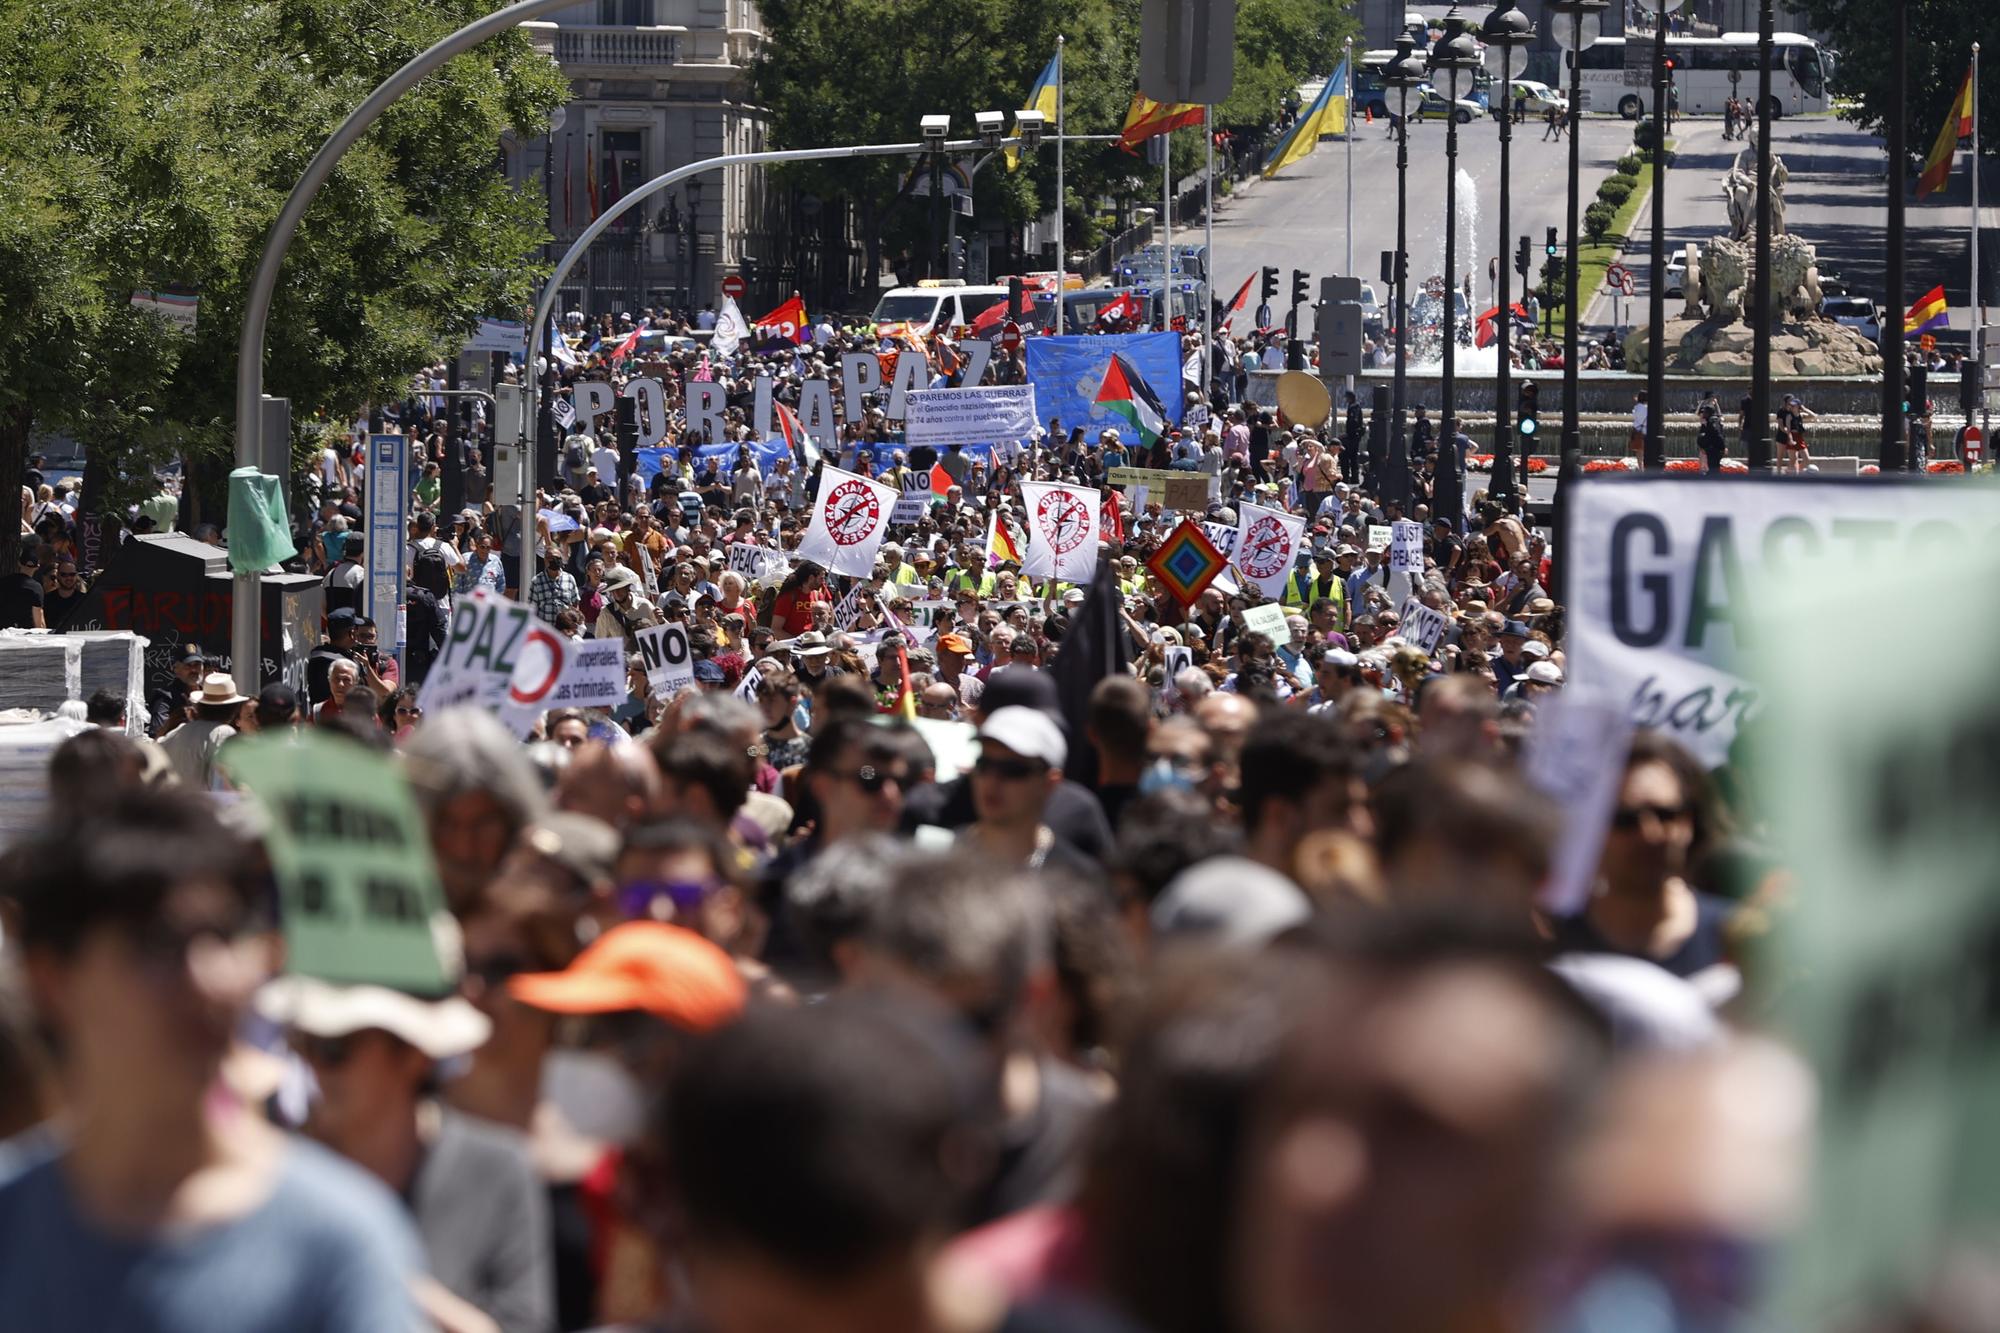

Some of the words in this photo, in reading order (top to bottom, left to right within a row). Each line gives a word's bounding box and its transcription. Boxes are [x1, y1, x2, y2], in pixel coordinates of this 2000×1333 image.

[573, 378, 726, 446] POR
[842, 340, 992, 422] PAZ
[920, 392, 962, 401] PAREMOS
[964, 390, 981, 399] LAS
[985, 389, 1028, 398] GUERRAS
[915, 416, 924, 424] 74
[926, 414, 942, 423] años
[944, 414, 965, 422] contra
[974, 412, 998, 422] pueblo
[925, 403, 959, 413] Genocidio
[834, 483, 865, 497] OTAN
[903, 472, 930, 491] NO
[863, 491, 878, 510] NO
[1068, 496, 1085, 513] NO
[825, 503, 842, 541] FUERA
[842, 517, 877, 544] BASES
[1057, 520, 1090, 552] BASES
[1275, 524, 1288, 545] NO
[1396, 526, 1420, 542] JUST
[731, 547, 761, 575] PEAC
[1251, 552, 1288, 577] BASES
[443, 602, 529, 673] PAZ
[639, 628, 688, 671] NO
